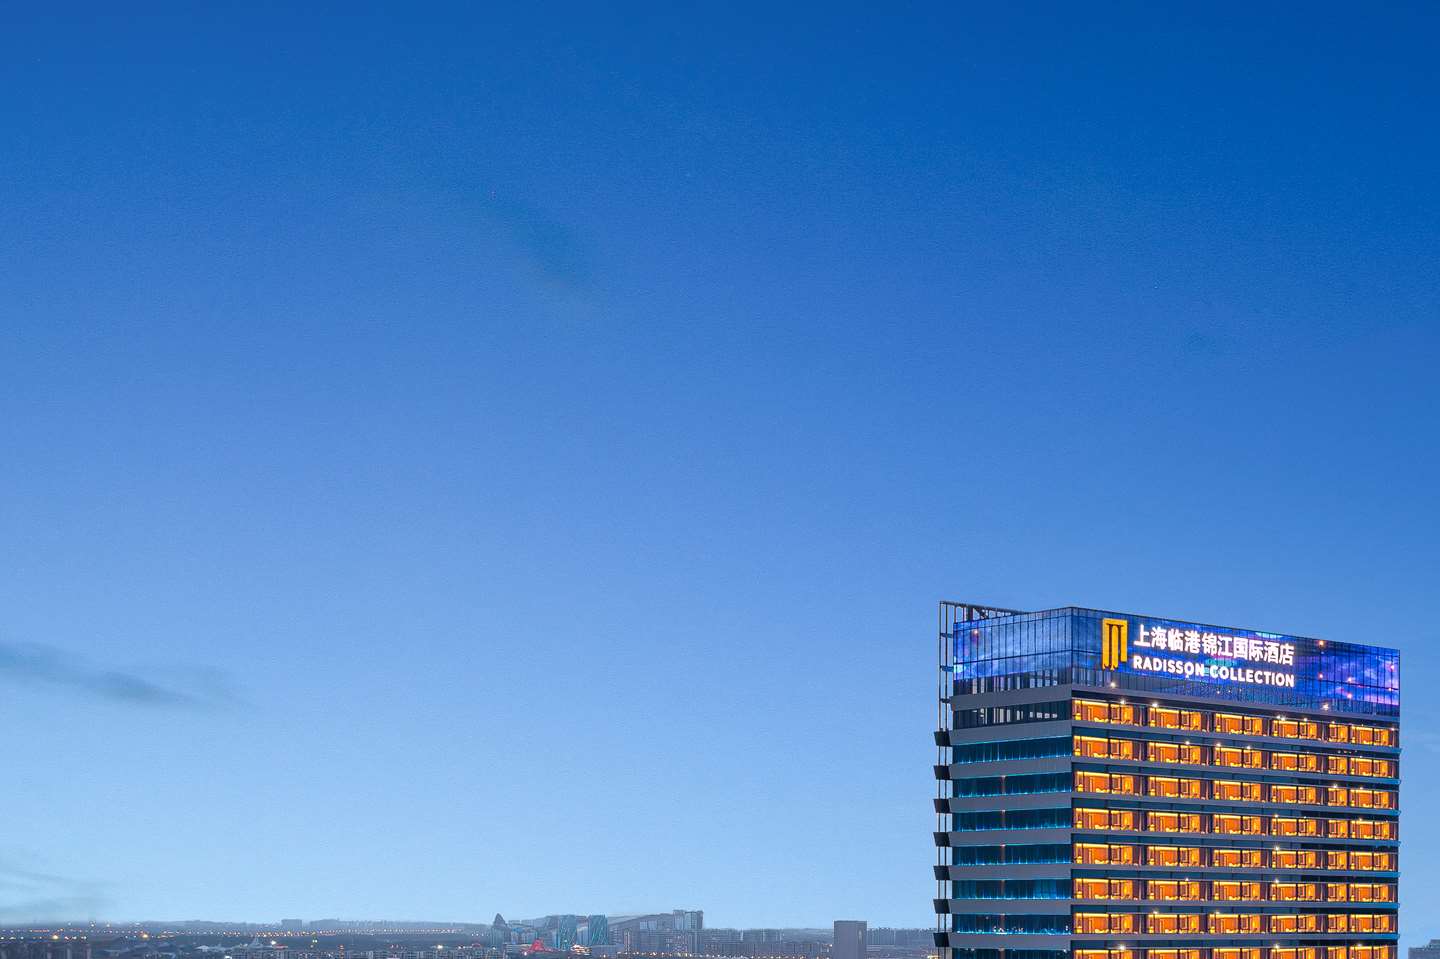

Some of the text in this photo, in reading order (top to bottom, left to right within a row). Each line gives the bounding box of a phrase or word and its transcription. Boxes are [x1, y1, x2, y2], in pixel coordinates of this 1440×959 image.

[1133, 624, 1295, 666] 上海临港锦江国际酒店
[1133, 656, 1295, 687] RADISSON COLLECTION
